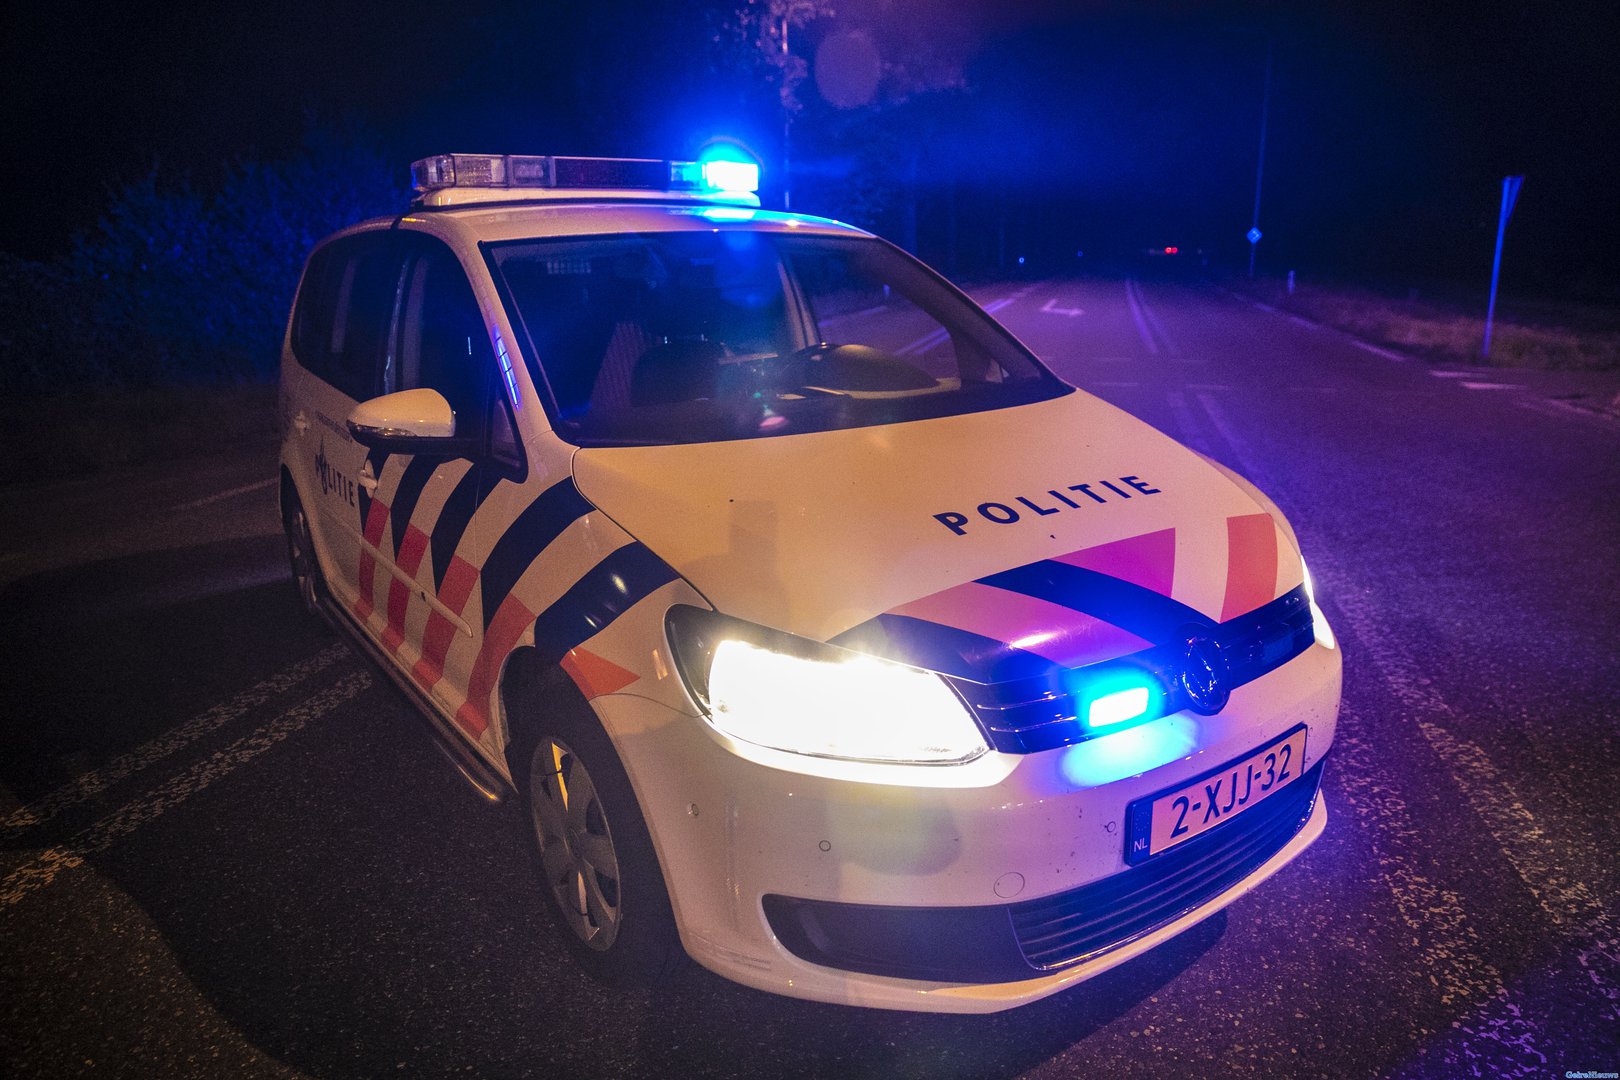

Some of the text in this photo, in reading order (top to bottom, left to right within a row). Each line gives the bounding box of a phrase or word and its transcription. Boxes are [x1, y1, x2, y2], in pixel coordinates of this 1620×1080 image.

[932, 475, 1162, 536] POLITIE
[1170, 743, 1292, 839] 2-XJJ-32
[1133, 837, 1148, 852] NL
